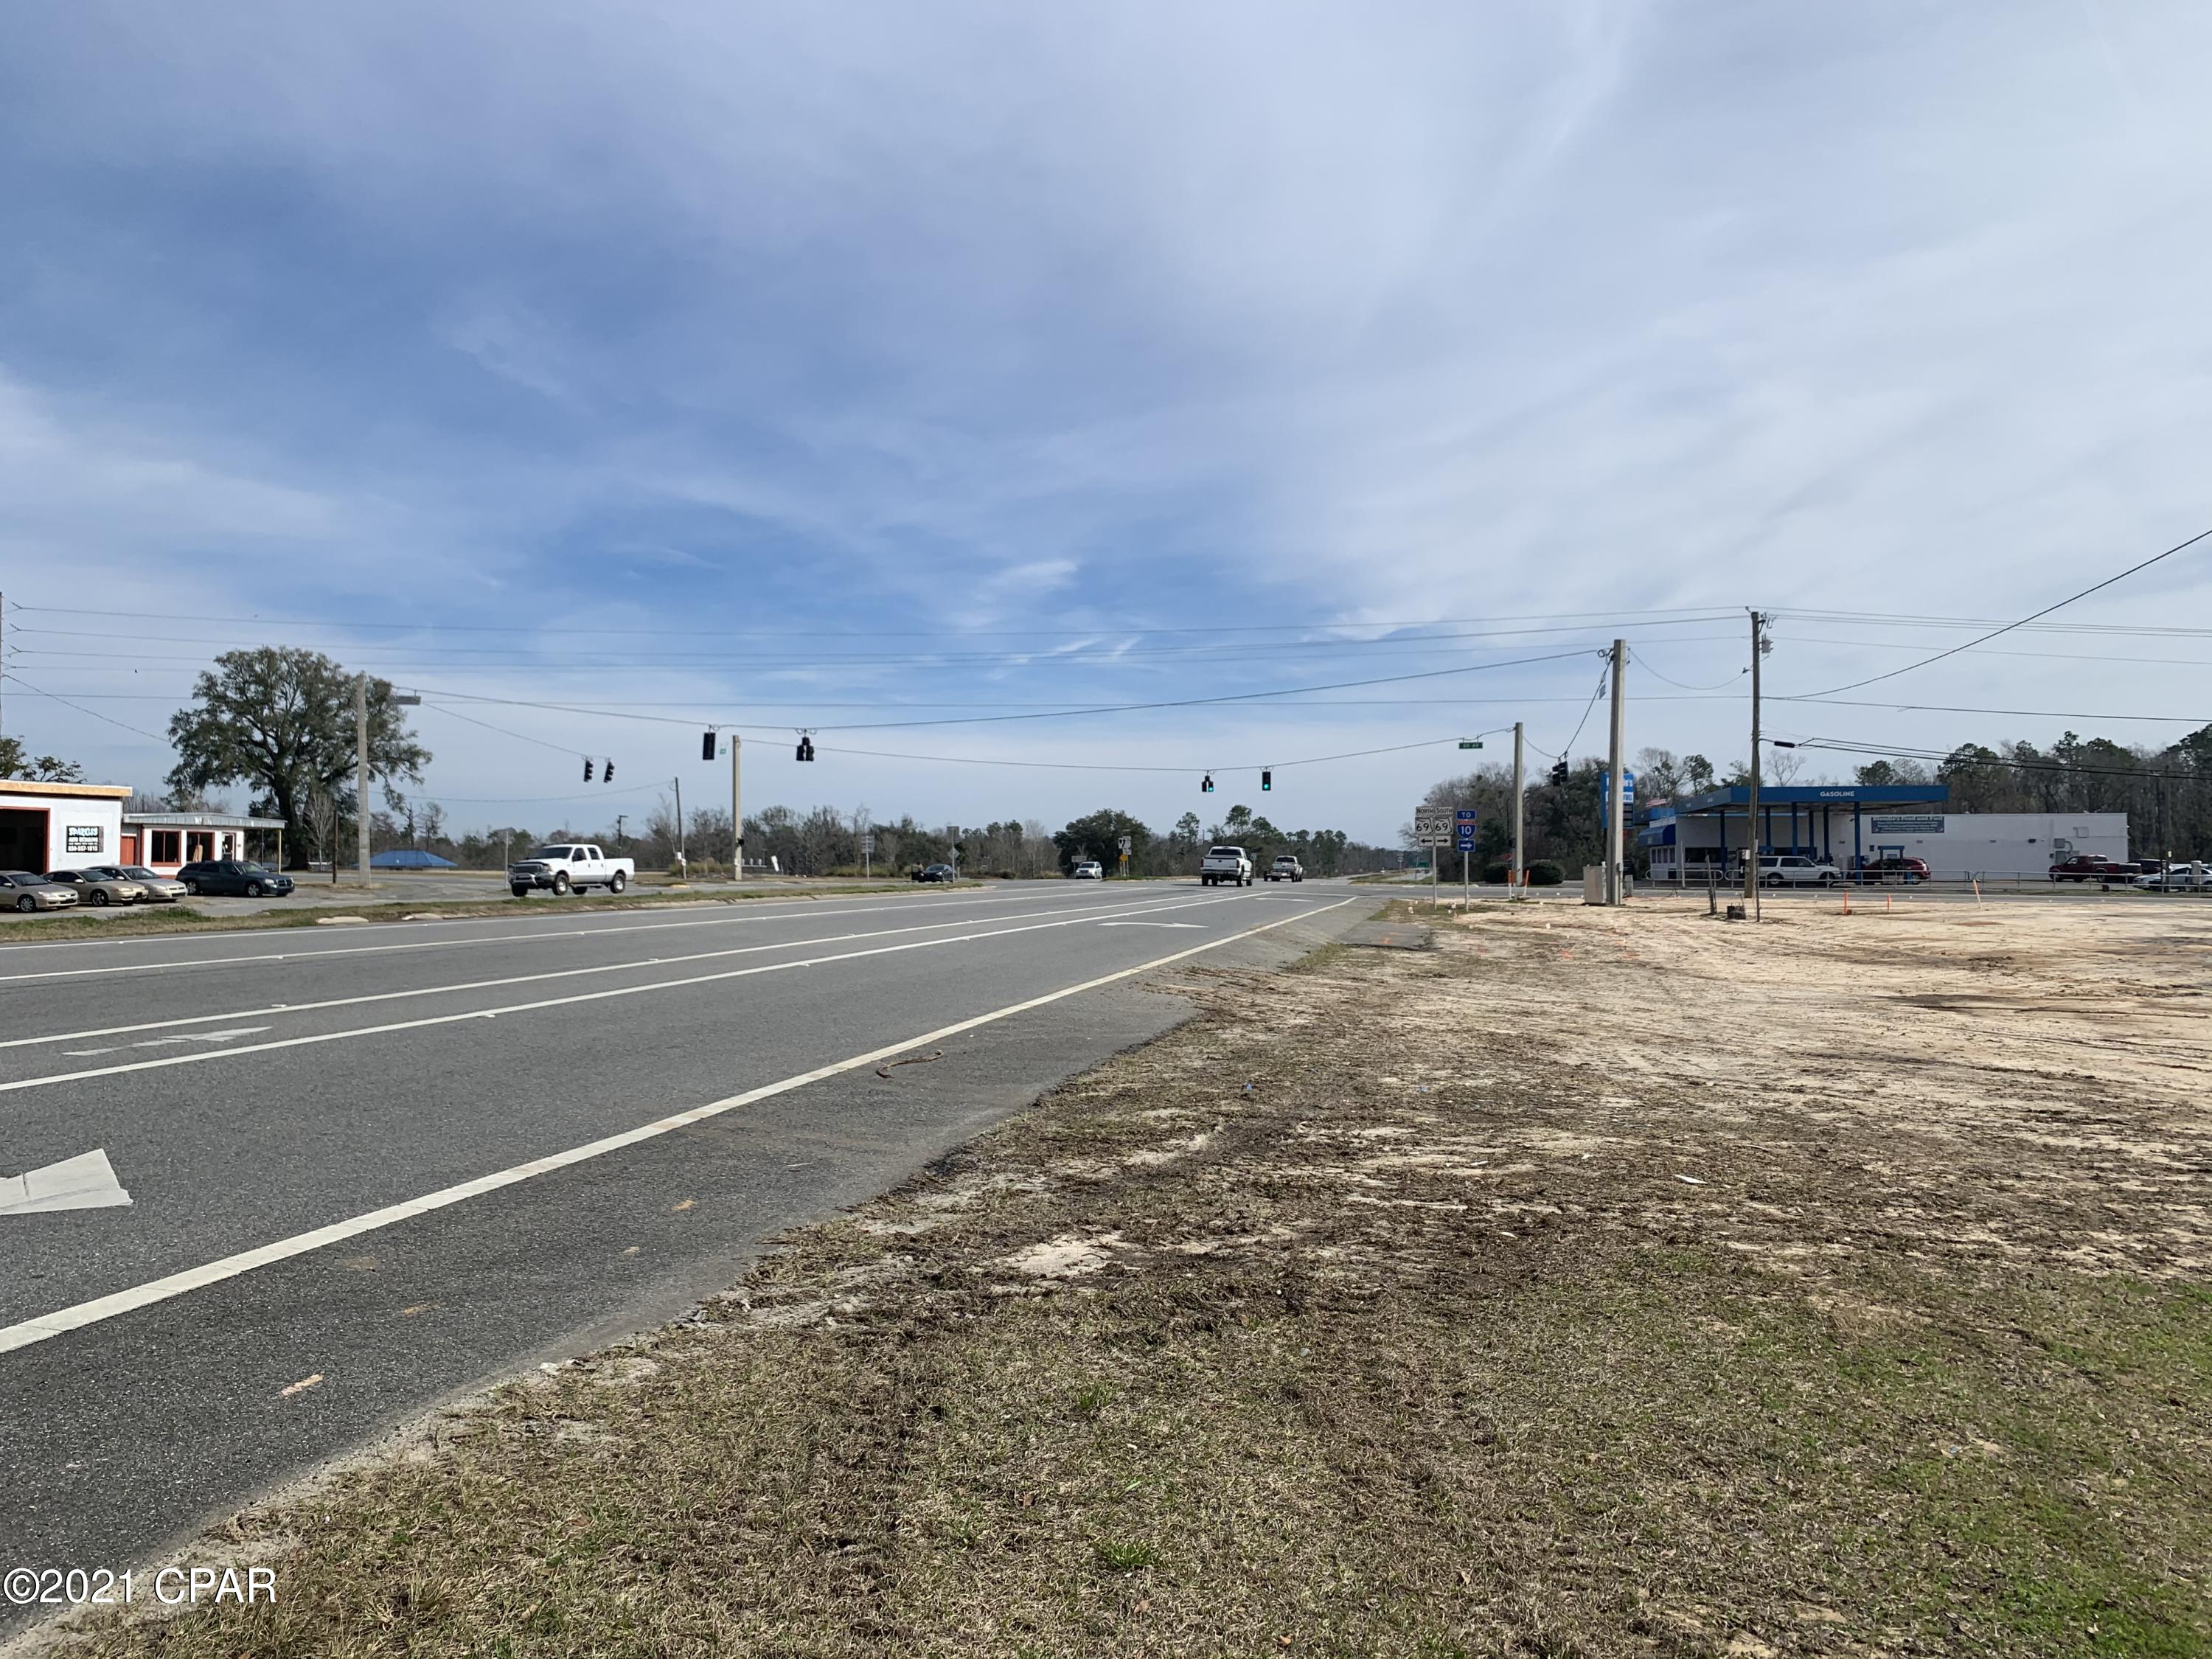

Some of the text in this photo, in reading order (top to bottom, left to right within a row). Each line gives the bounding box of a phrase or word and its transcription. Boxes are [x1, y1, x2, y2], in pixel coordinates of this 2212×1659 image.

[1416, 822, 1429, 832] 69
[1435, 822, 1448, 831] 69
[1461, 825, 1472, 834] 10
